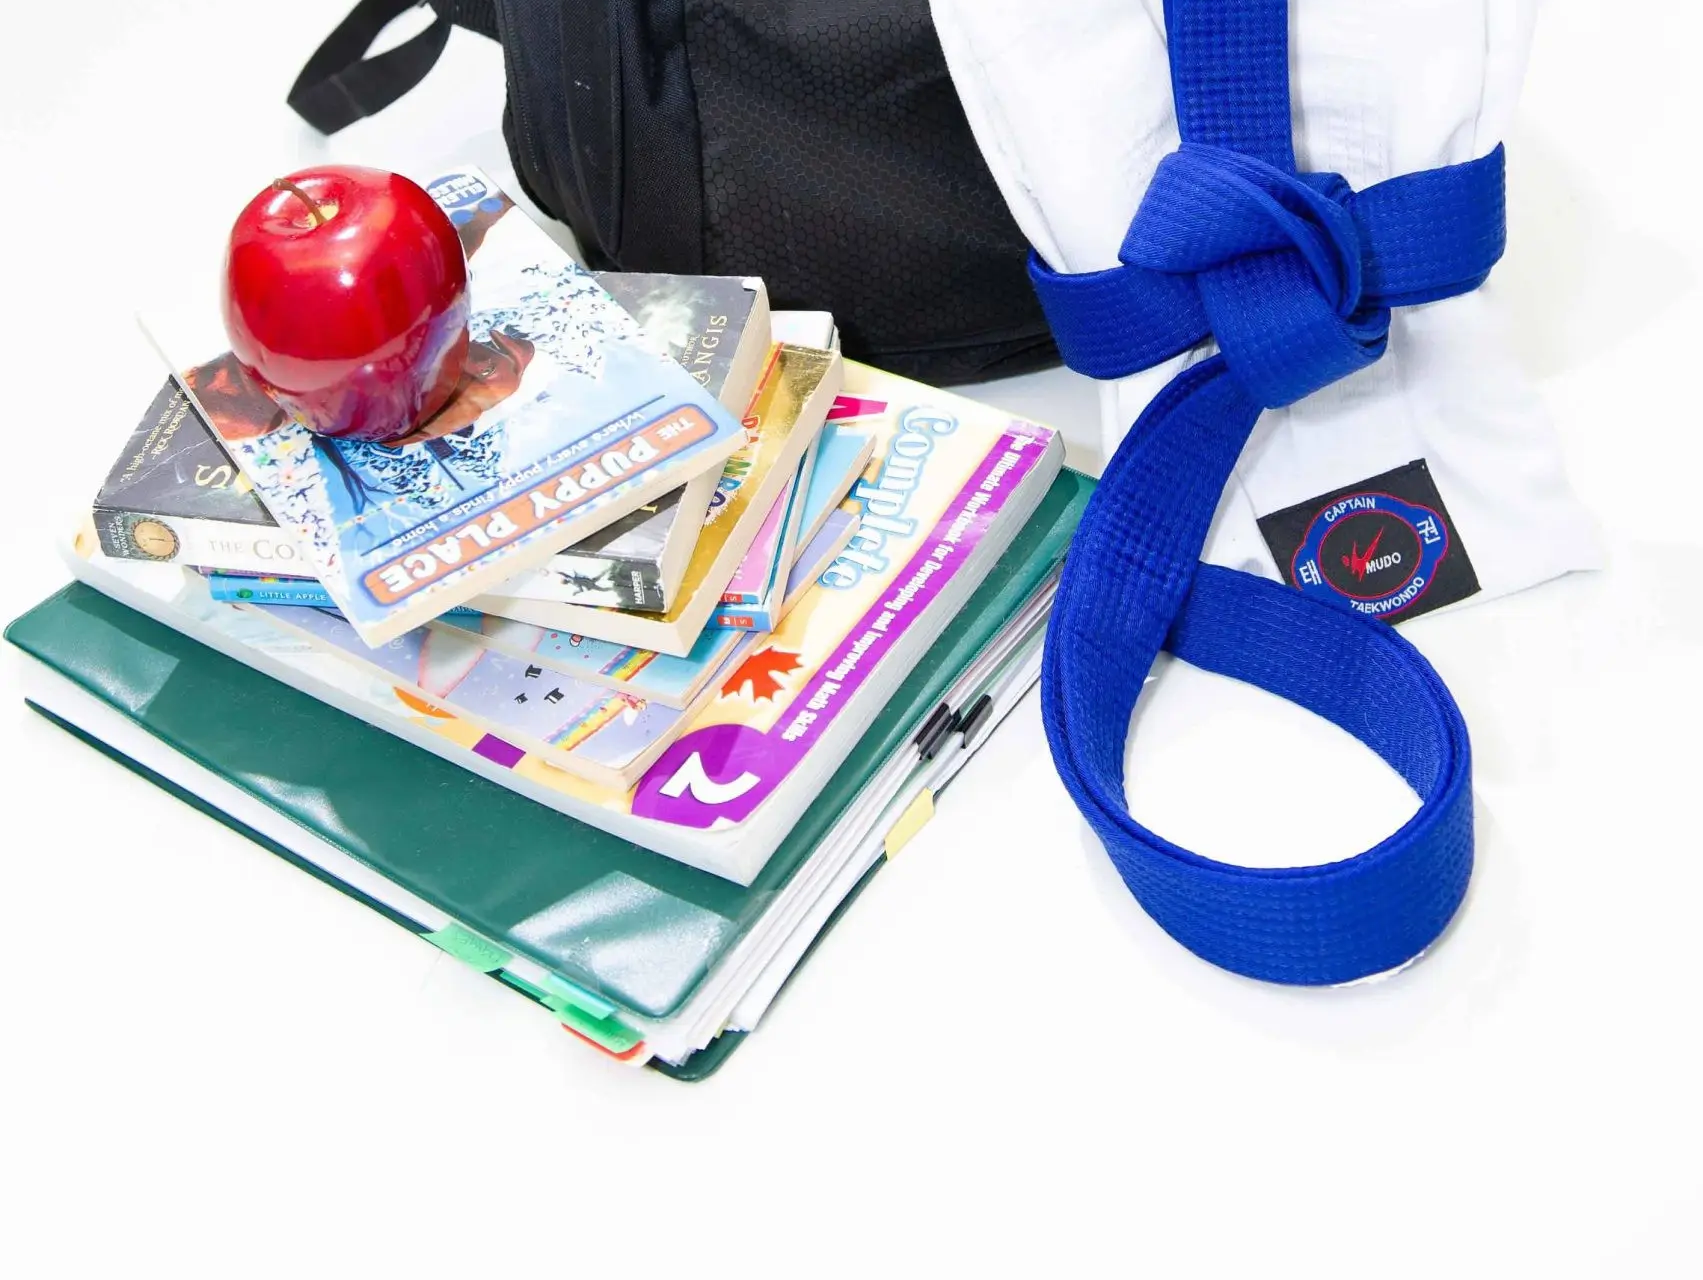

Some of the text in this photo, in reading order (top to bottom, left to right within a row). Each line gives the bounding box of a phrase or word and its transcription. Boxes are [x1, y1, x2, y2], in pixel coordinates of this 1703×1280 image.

[690, 315, 729, 386] ANGIS
[127, 425, 162, 472] high-octane
[160, 411, 171, 426] mix
[168, 398, 177, 409] of
[498, 463, 541, 496] puppy
[980, 451, 1022, 492] Ultimate
[378, 417, 696, 594] THE PUPPY PLACE
[820, 405, 956, 588] Complete
[1324, 496, 1376, 522] CAPTAIN
[392, 521, 440, 548] home
[944, 491, 992, 545] Workbook
[111, 521, 120, 551] SEVEN
[118, 516, 130, 556] WONDERS
[209, 540, 244, 553] THE
[932, 543, 955, 561] for
[1299, 559, 1322, 586] 태
[1365, 551, 1402, 574] MUDO
[259, 591, 328, 601] LITTLE APPLE
[631, 570, 643, 605] HARPER
[884, 560, 943, 612] Developing
[1350, 576, 1425, 614] TAEKWONDO
[872, 612, 897, 632] and
[825, 630, 883, 682] Improving
[806, 681, 841, 710] Math
[781, 710, 818, 742] Skills
[659, 751, 762, 804] 2
